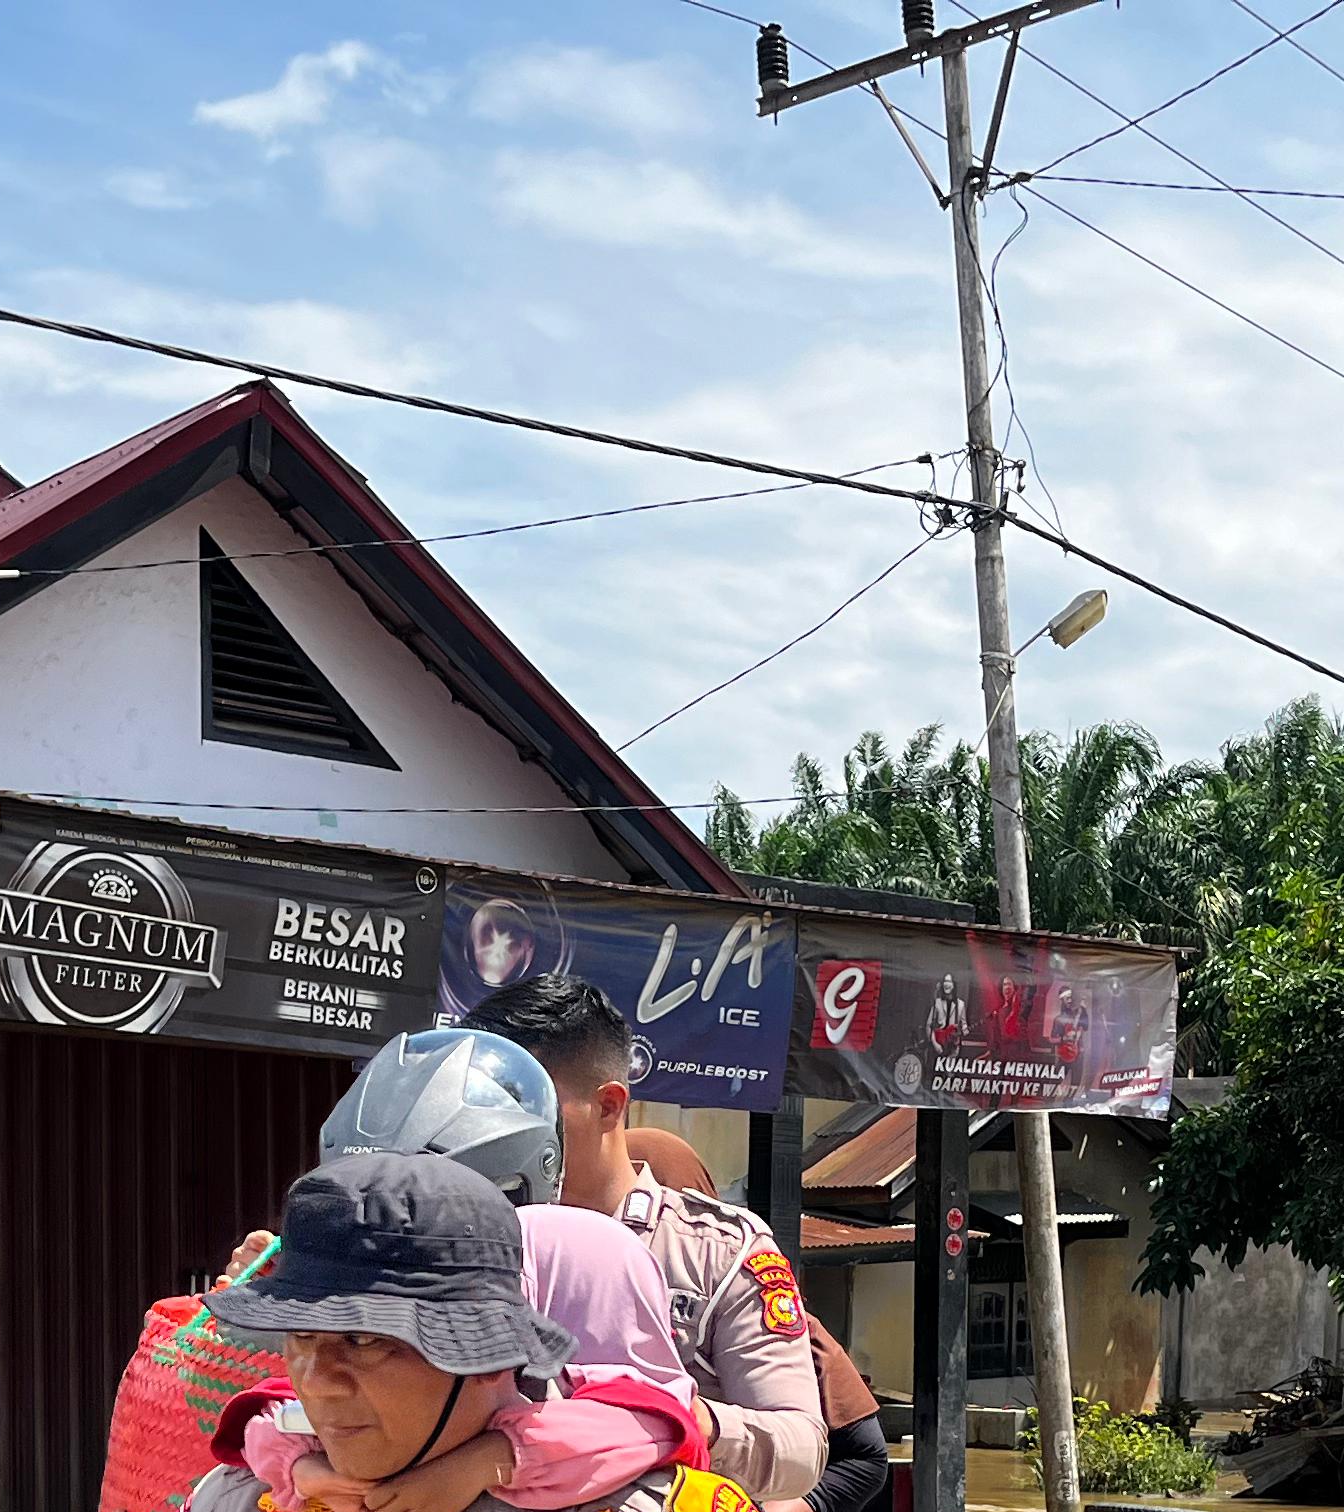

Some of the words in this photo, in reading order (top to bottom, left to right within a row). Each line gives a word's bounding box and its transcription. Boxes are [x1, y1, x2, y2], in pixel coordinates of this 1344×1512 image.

[97, 881, 127, 898] 234
[274, 898, 405, 956] BESAR
[269, 941, 403, 979] BERKUALITAS
[55, 964, 143, 993] FILTER
[283, 979, 355, 1007] BERANI
[312, 1005, 373, 1030] BESAR
[719, 1007, 761, 1028] ICE
[935, 1056, 1002, 1075] KUALITAS
[1003, 1061, 1066, 1079] MENYALA
[931, 1076, 968, 1092] DARI
[970, 1078, 1020, 1096] WAKTU
[1022, 1081, 1040, 1097] KE
